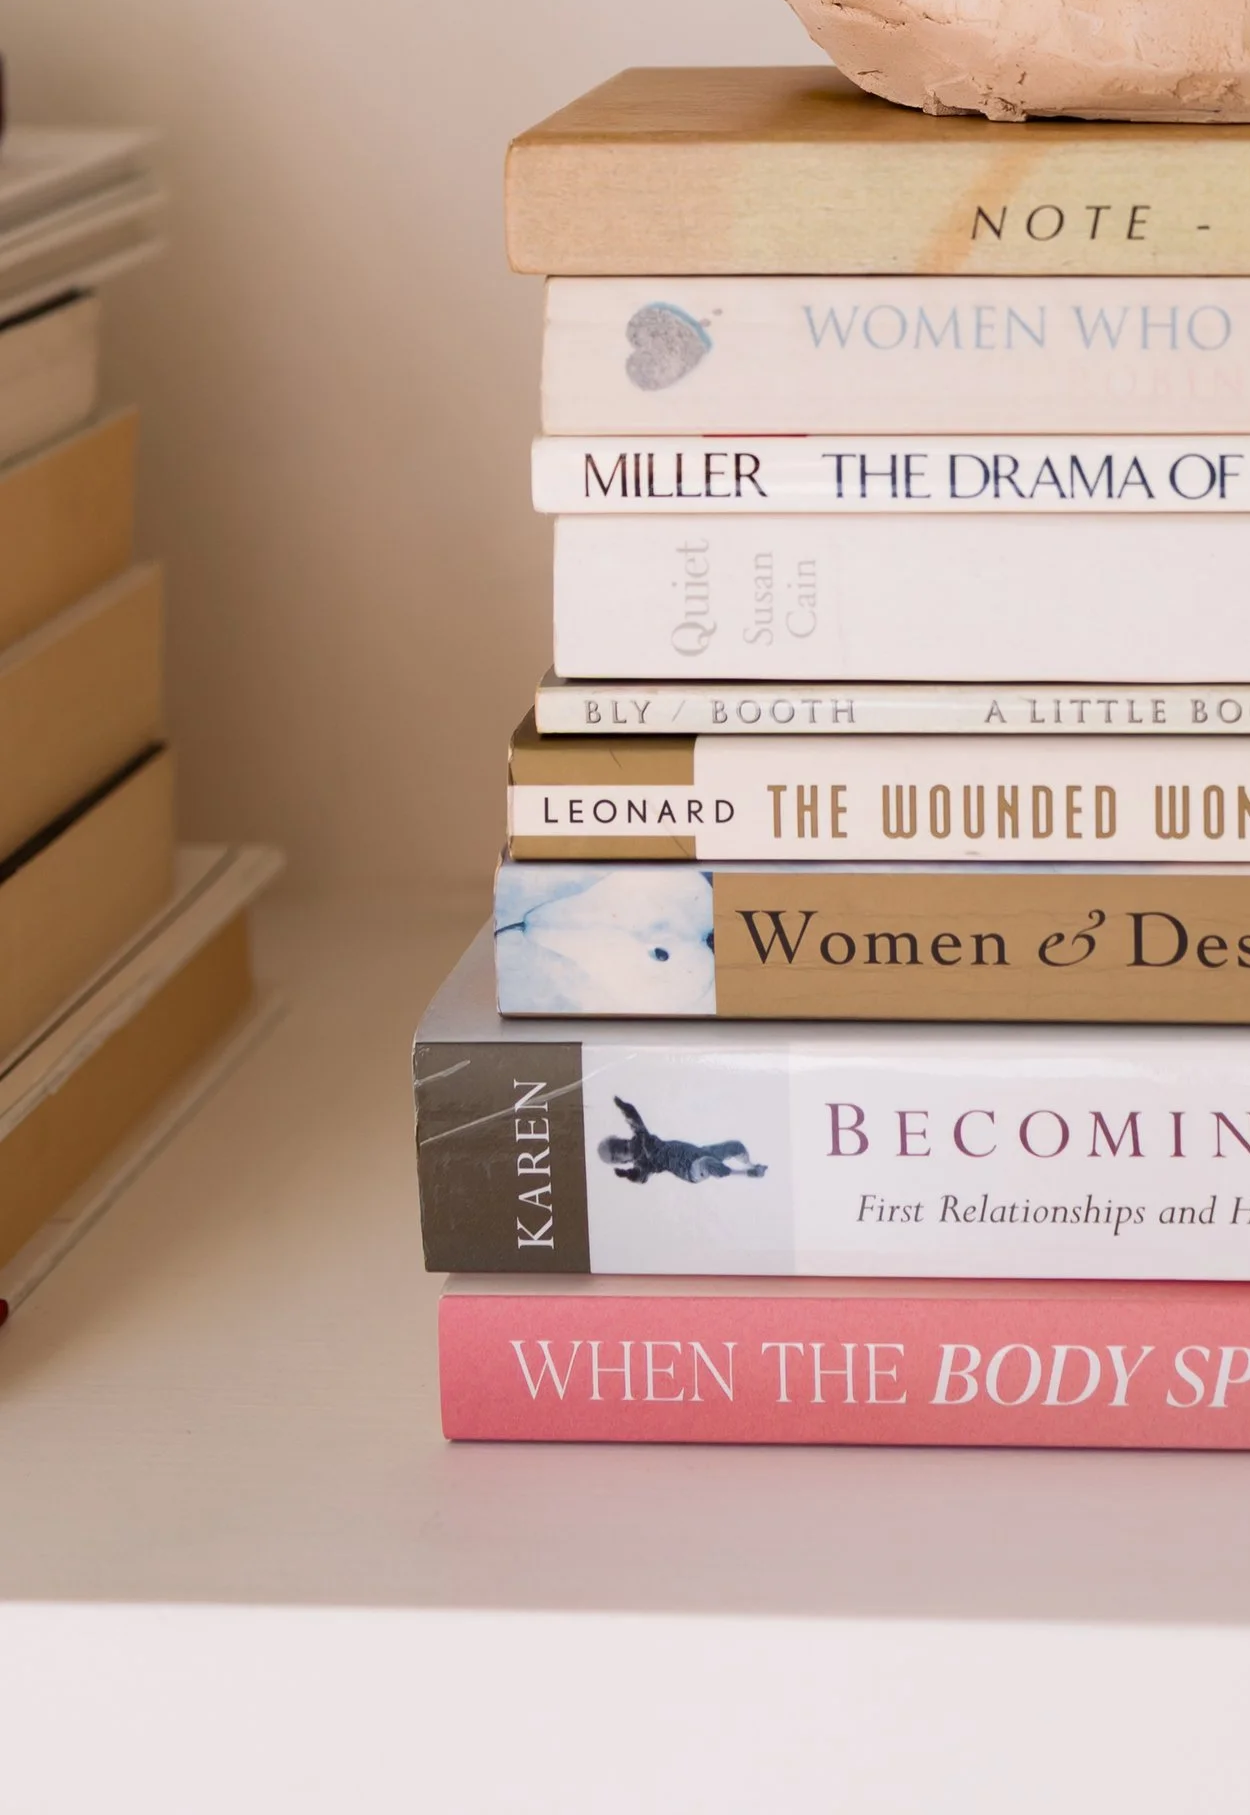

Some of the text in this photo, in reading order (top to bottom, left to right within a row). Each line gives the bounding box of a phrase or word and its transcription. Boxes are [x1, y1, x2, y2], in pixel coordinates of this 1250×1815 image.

[970, 205, 1151, 241] NOTE
[799, 304, 1046, 350] WOMEN
[1070, 305, 1232, 352] WHO
[585, 452, 768, 498] MILLER
[821, 453, 931, 499] THE
[949, 454, 1155, 499] DRAMA
[1168, 453, 1244, 500] OF
[670, 537, 718, 658] Quiet
[742, 551, 775, 647] Susan
[785, 559, 817, 639] Cain
[585, 700, 651, 724] BLY
[711, 699, 855, 725] BOOTH
[983, 699, 1007, 724] A
[1028, 699, 1167, 724] LITTLE
[544, 796, 735, 824] LEONARD
[766, 784, 848, 839] THE
[881, 783, 1117, 840] WOUNDED
[734, 910, 1011, 966] Women
[1038, 908, 1106, 967] &
[512, 1079, 555, 1249] KAREN
[857, 1194, 923, 1223] First
[939, 1193, 1146, 1237] Relationships
[1158, 1194, 1217, 1225] and
[508, 1339, 739, 1402] WHEN
[761, 1341, 907, 1404] THE
[930, 1343, 1156, 1407] BODY
